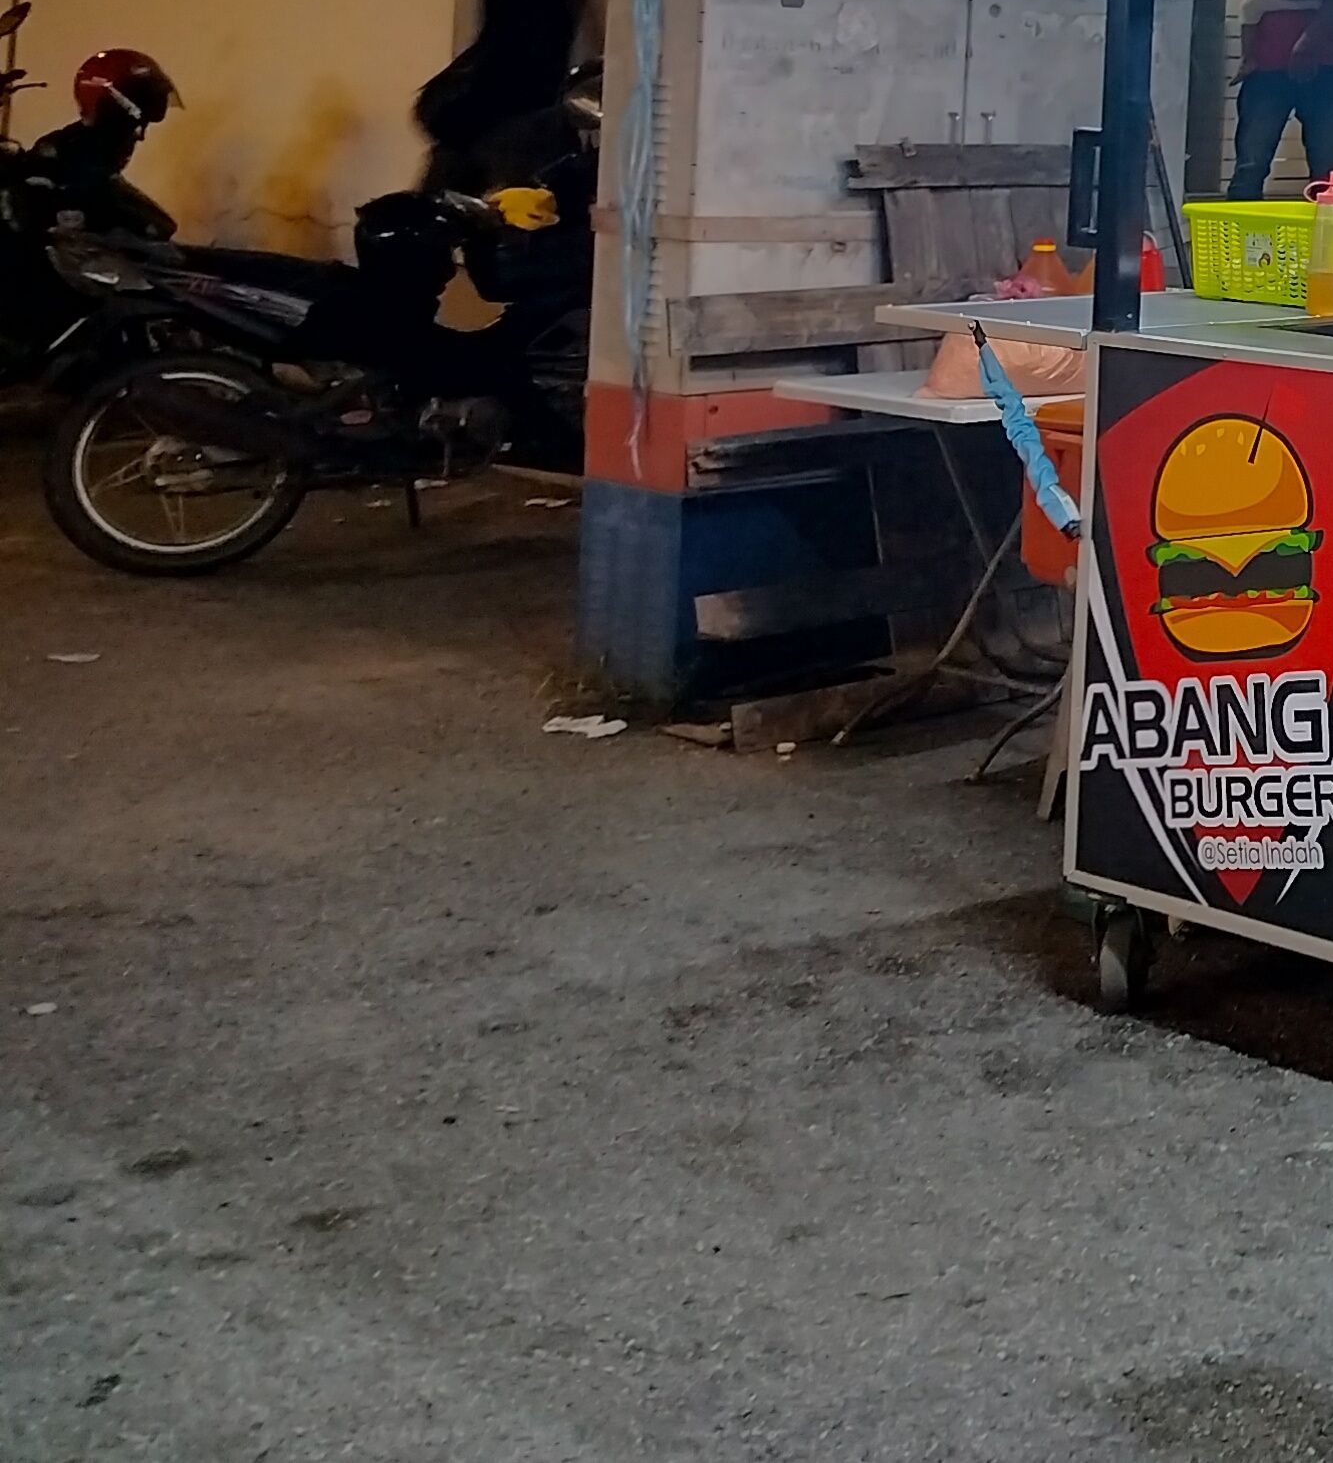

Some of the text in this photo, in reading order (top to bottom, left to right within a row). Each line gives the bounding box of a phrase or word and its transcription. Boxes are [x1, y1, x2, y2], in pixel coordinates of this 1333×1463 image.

[1081, 674, 1329, 766] ABANG
[1203, 839, 1320, 866] @Setia Indah
